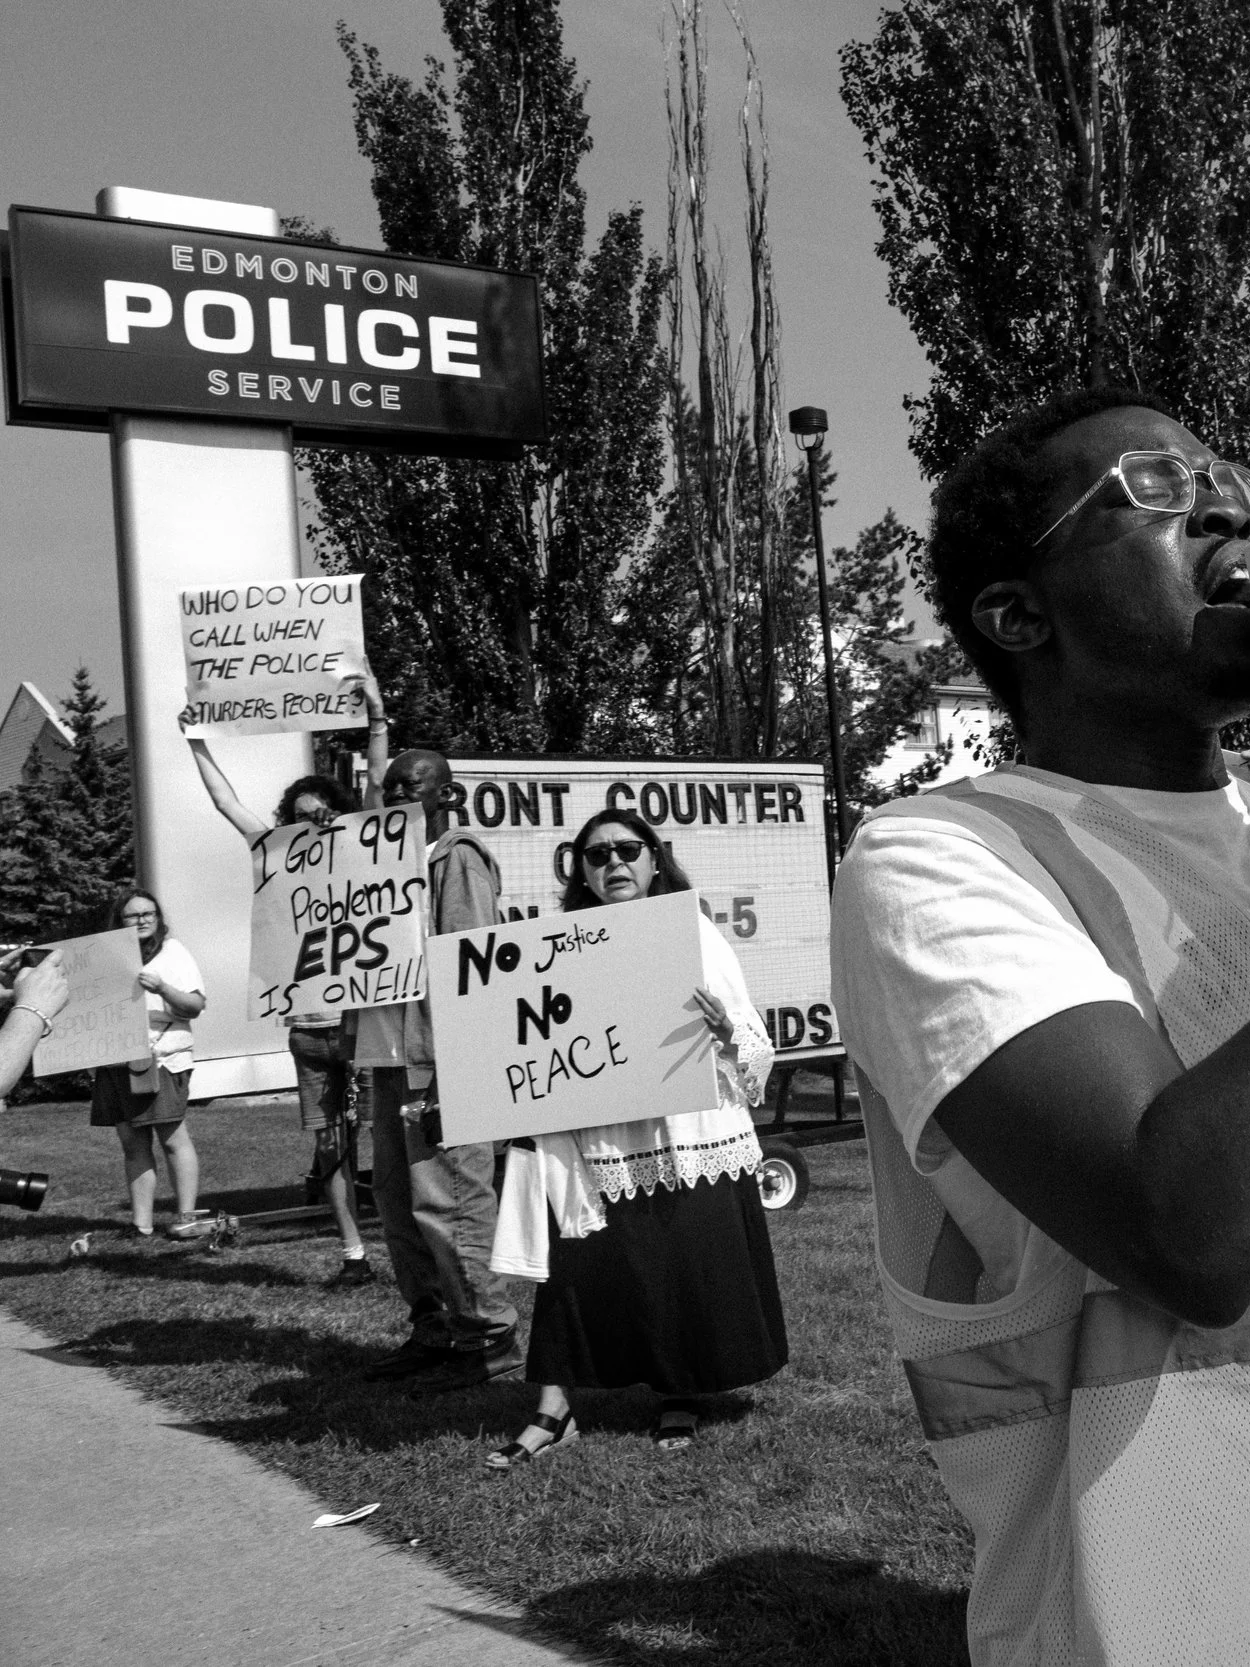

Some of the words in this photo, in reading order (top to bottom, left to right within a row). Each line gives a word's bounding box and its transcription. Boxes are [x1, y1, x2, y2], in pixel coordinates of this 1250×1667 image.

[171, 245, 418, 298] EDMONTON
[104, 279, 481, 378] POLICE
[208, 369, 401, 409] SERVICE
[182, 590, 238, 615] WHO
[246, 586, 286, 609] DO
[296, 582, 352, 608] YOU
[190, 624, 246, 647] CALL
[254, 618, 324, 642] WHEN
[190, 657, 244, 680] THE
[249, 652, 344, 675] POLICE
[283, 689, 364, 718] PEOPLE?
[445, 782, 570, 828] RONT
[606, 782, 805, 826] COUNTER
[251, 829, 277, 894] I
[360, 810, 407, 864] 99
[294, 916, 391, 981] EPS
[535, 923, 610, 973] Justice
[260, 983, 300, 1017] IS
[323, 954, 422, 1003] ONE!!!
[506, 1025, 628, 1104] PEACE
